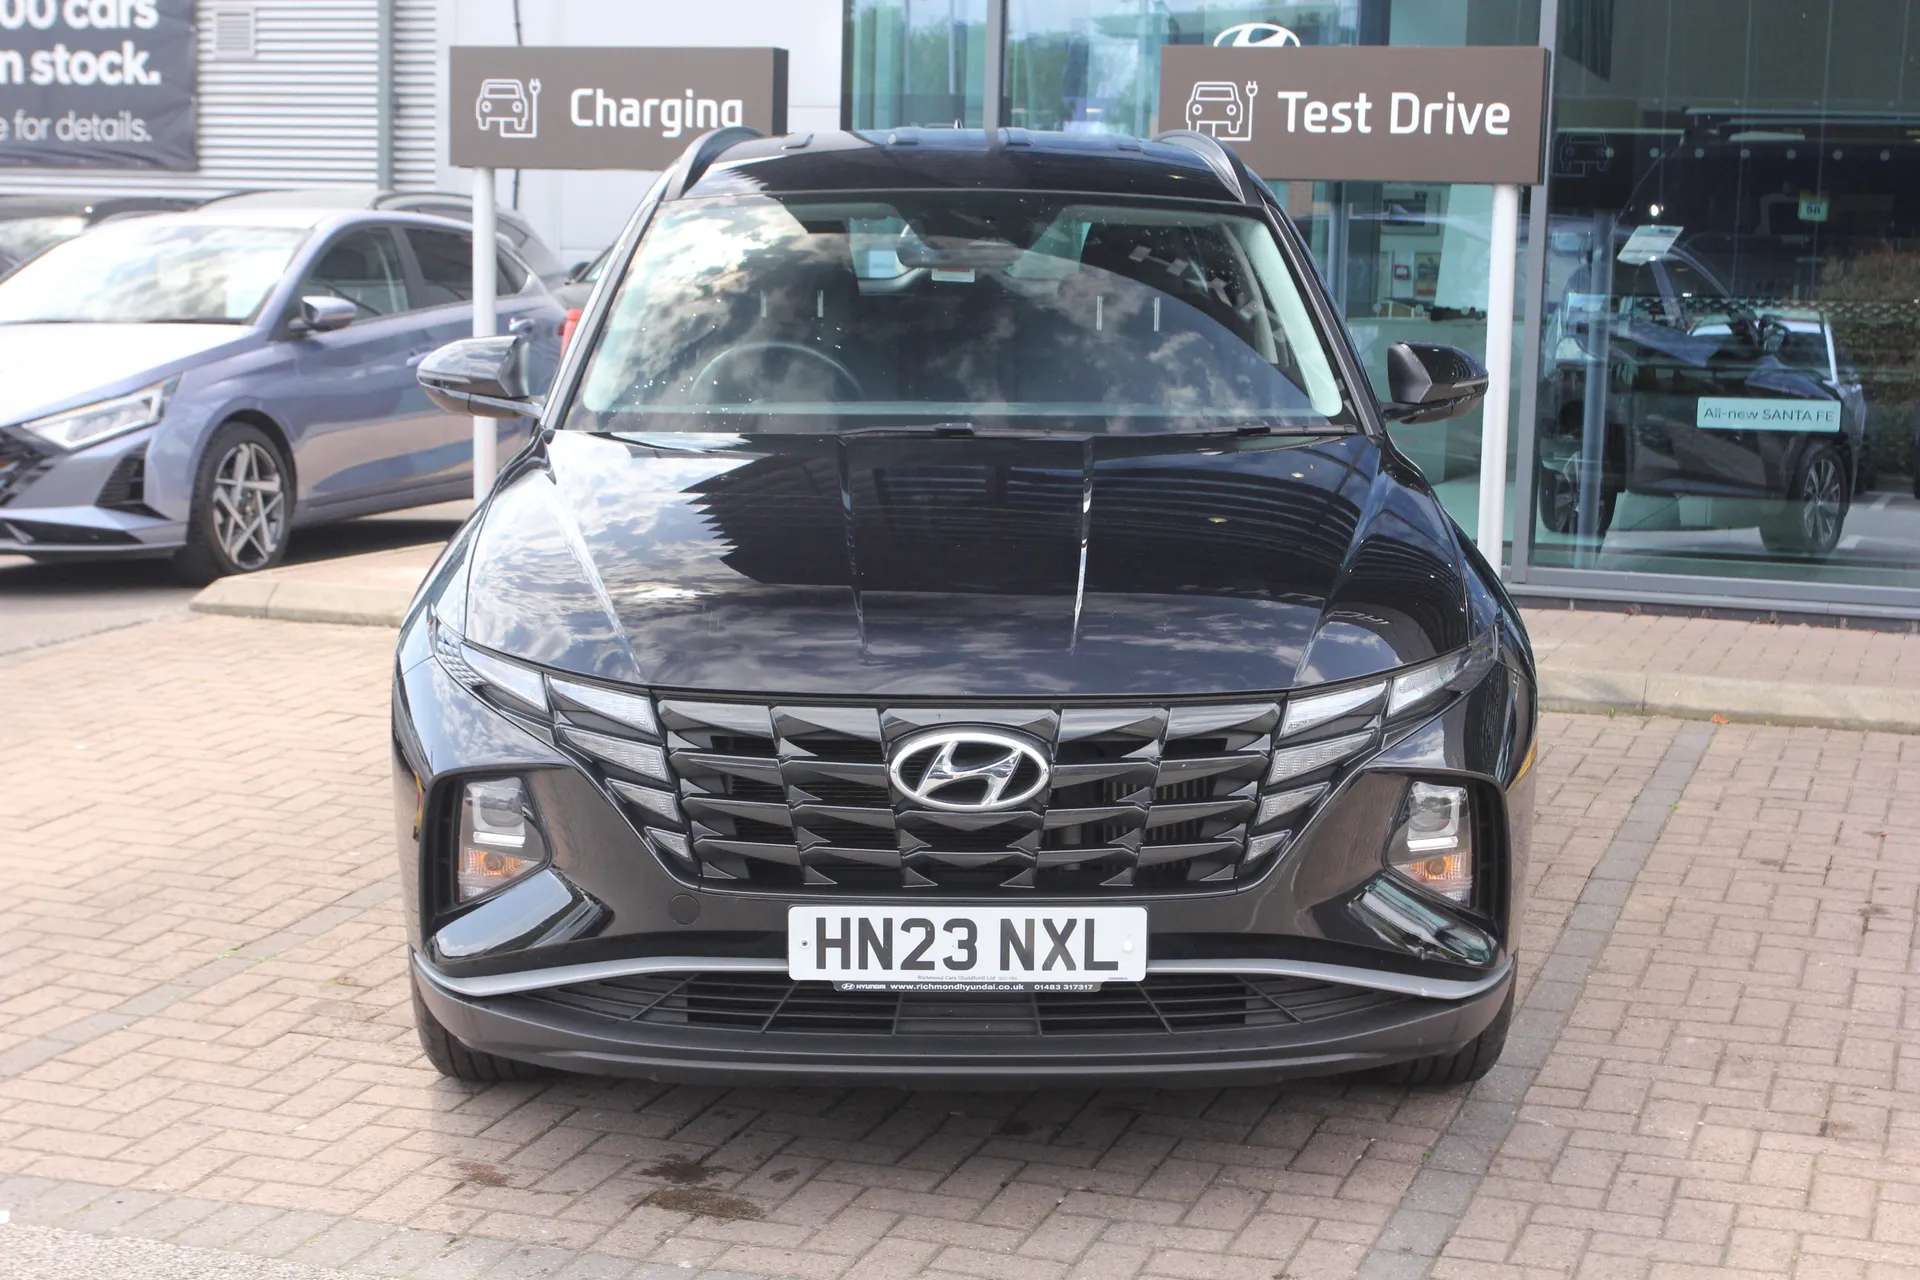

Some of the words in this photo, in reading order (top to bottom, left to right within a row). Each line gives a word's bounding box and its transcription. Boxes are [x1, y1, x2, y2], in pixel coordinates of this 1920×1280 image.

[63, 0, 159, 29] cars
[30, 40, 161, 85] stock.
[14, 109, 52, 141] for
[55, 110, 152, 142] details.
[571, 88, 743, 138] Charging
[1277, 91, 1372, 133] Test
[1390, 92, 1510, 135] Drive
[1703, 407, 1759, 419] All-new
[1763, 408, 1812, 421] SANTA
[1817, 411, 1834, 421] FE
[815, 917, 978, 971] HN23
[1000, 918, 1119, 971] NXL
[890, 983, 1025, 992] www.richmondhyundai.co.uk
